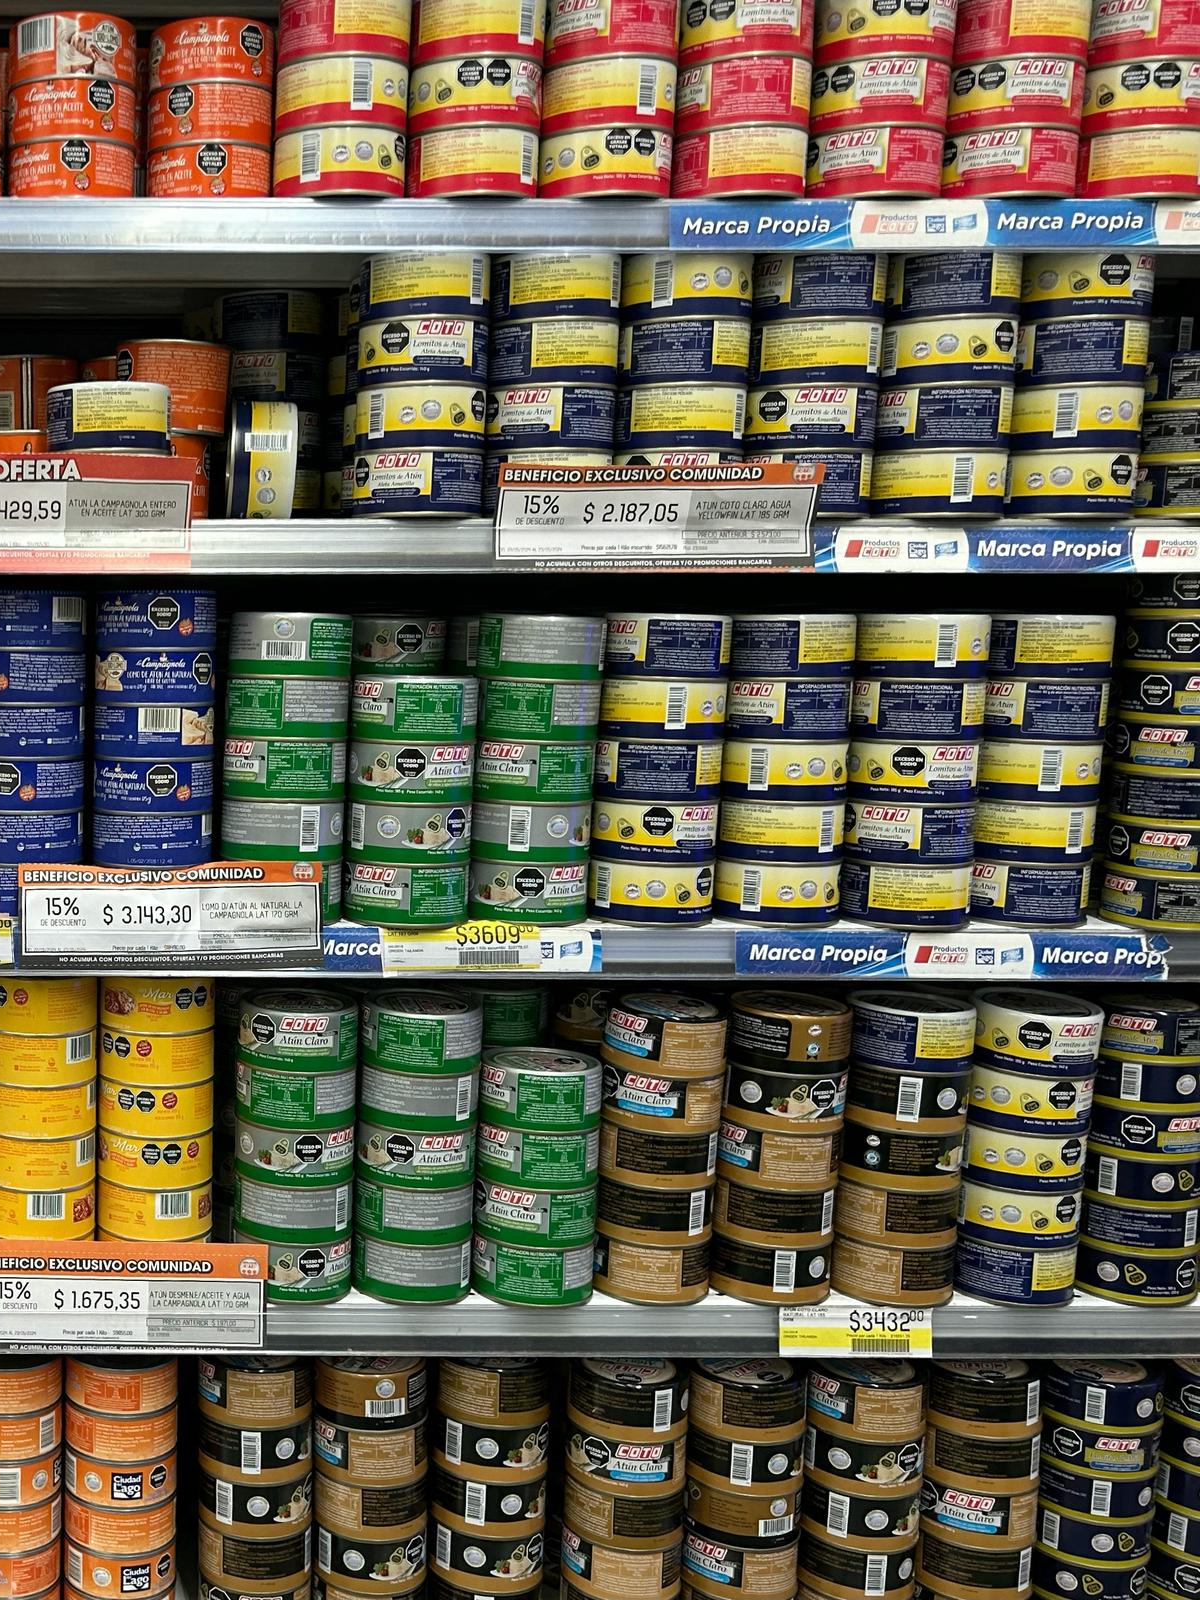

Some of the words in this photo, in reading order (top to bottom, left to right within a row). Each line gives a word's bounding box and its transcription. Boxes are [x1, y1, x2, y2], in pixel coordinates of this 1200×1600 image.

[863, 60, 920, 78] COTO
[1014, 60, 1069, 78] COTO
[859, 81, 892, 89] Lomitos
[900, 79, 918, 87] Atún
[683, 217, 750, 235] Marca
[756, 214, 831, 234] Propia
[997, 213, 1065, 230] Marca
[1074, 212, 1144, 233] Propia
[417, 319, 466, 336] COTO
[503, 388, 552, 404] COTO
[794, 387, 848, 404] COTO
[504, 469, 581, 482] BENEFICIO
[584, 469, 665, 481] EXCLUSIVO
[669, 467, 762, 481] COMUNIDAD
[81, 509, 90, 517] EN
[92, 509, 116, 517] ACEITE
[101, 500, 147, 509] CAMPAGNOLA
[150, 500, 176, 509] ENTERO
[524, 495, 559, 514] 15%
[696, 502, 717, 510] ATUN
[720, 501, 740, 510] COTO
[742, 501, 768, 509] CLARO
[770, 500, 791, 508] AGUA
[515, 517, 524, 525] DE
[526, 517, 564, 525] DESCUENTO
[583, 503, 594, 524] $
[602, 503, 679, 524] 2.187,05
[698, 511, 738, 520] YELLOWFIN
[741, 511, 756, 519] LAT
[977, 539, 1046, 557] Marca
[1052, 540, 1122, 561] Propia
[431, 746, 470, 762] COTO
[480, 742, 525, 759] COTO
[933, 747, 974, 761] COTO
[23, 870, 94, 884] BENEFICIO
[98, 870, 173, 885] EXCLUSIVO
[177, 867, 264, 882] COMUNIDAD
[354, 864, 398, 882] COTO
[45, 896, 79, 916] 15%
[202, 903, 220, 911] LOMO
[294, 901, 303, 909] LA
[40, 919, 49, 927] DE
[51, 919, 87, 927] DESCUENTO
[103, 905, 113, 926] $
[122, 905, 192, 926] 3.143,30
[210, 911, 253, 919] CAMPAGNOLA
[456, 926, 520, 946] $3609
[749, 944, 814, 961] Marca
[821, 945, 888, 967] Propia
[933, 945, 969, 953] Productos
[929, 953, 968, 963] COTO
[279, 1016, 329, 1032] COTO
[49, 1258, 124, 1272] EXCLUSIVO
[126, 1260, 212, 1273] COMUNIDAD
[2, 1302, 38, 1310] DESCUENTO
[54, 1289, 64, 1310] $
[72, 1290, 140, 1311] 1.675,35
[850, 1310, 910, 1332] $3432
[910, 1310, 924, 1321] 00
[616, 1443, 663, 1460] COTO
[943, 1490, 996, 1513] COTO
